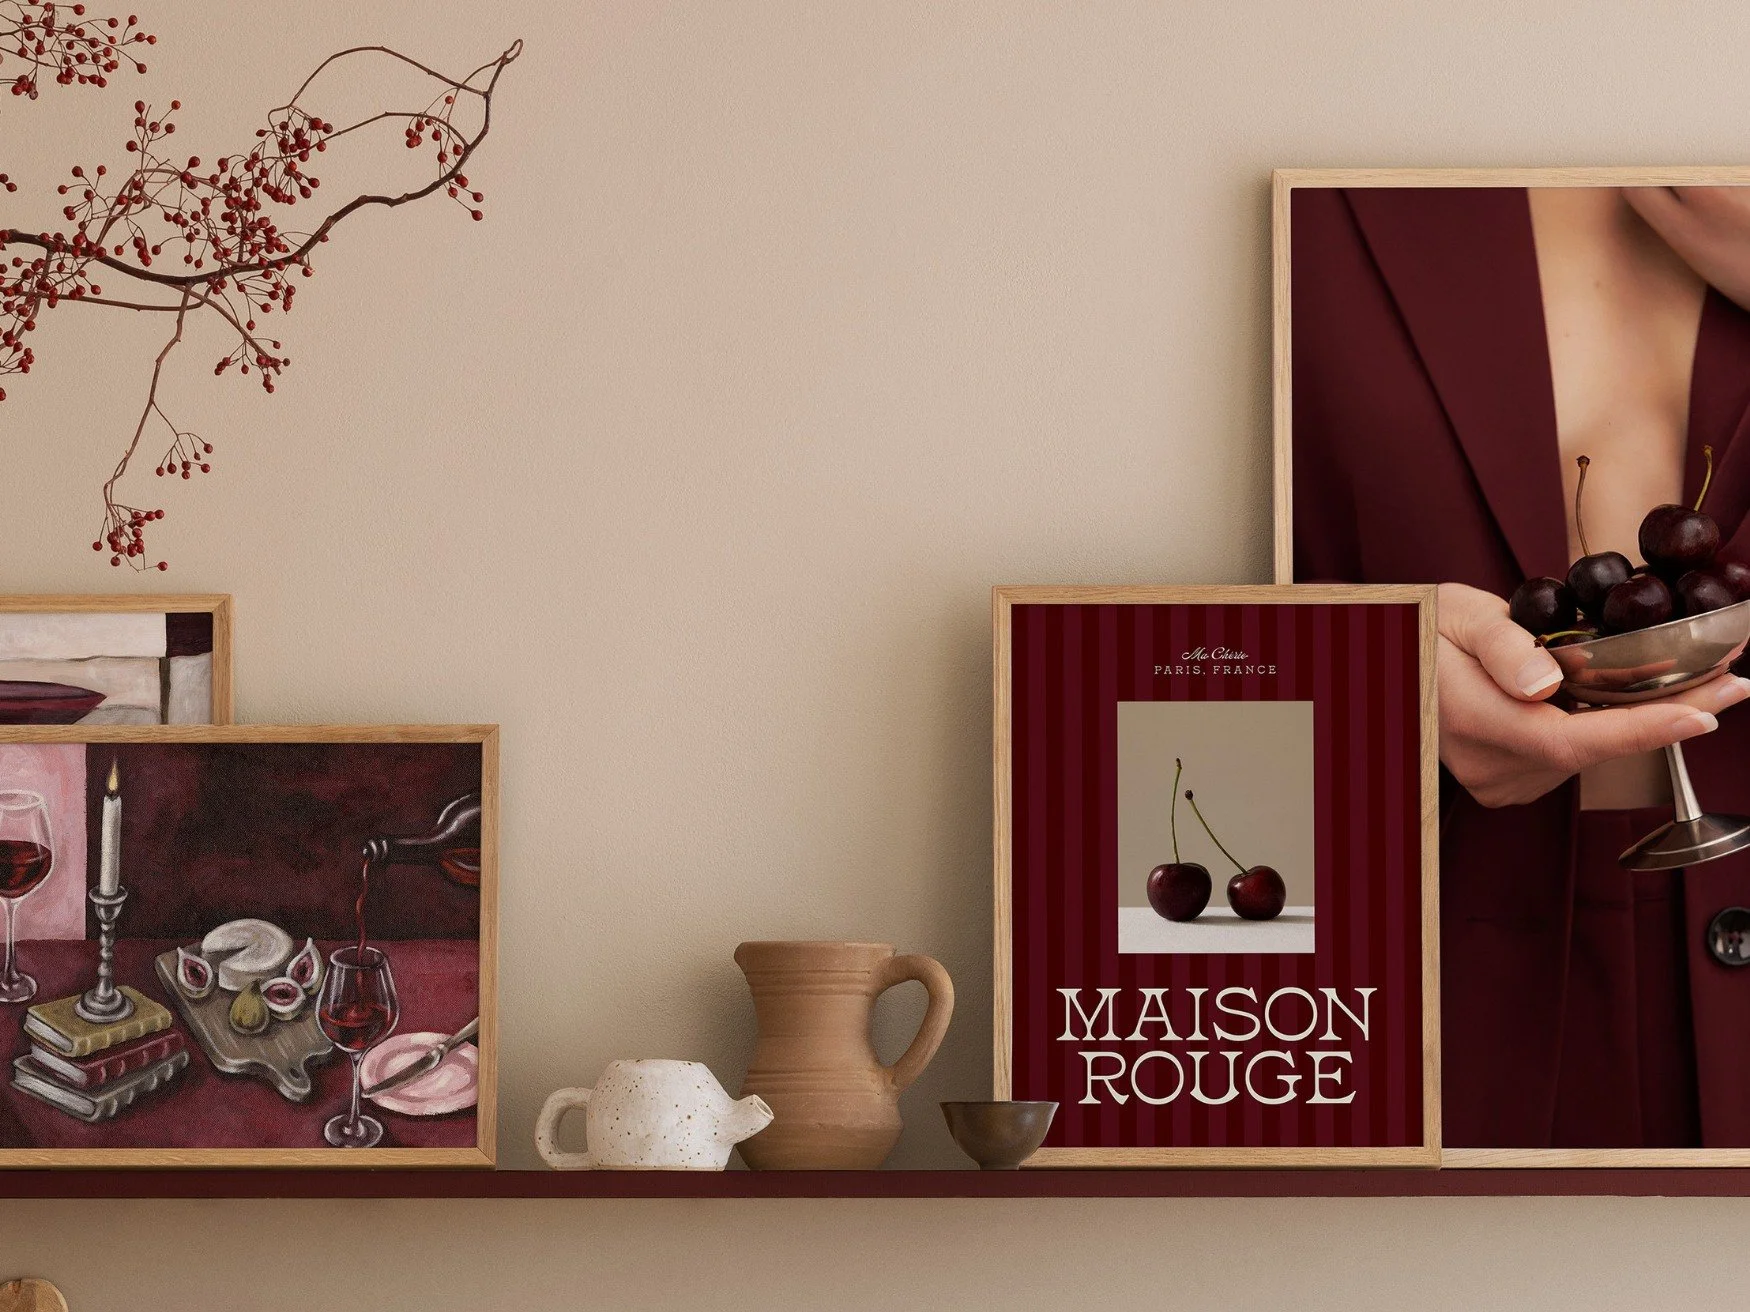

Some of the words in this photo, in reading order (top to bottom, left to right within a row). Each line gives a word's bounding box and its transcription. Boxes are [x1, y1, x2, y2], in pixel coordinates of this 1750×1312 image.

[1154, 665, 1206, 676] PARIS,
[1212, 664, 1277, 675] FRANCE
[1181, 646, 1210, 662] Ma
[1055, 986, 1378, 1042] MAISON
[1077, 1049, 1357, 1106] ROUGE
